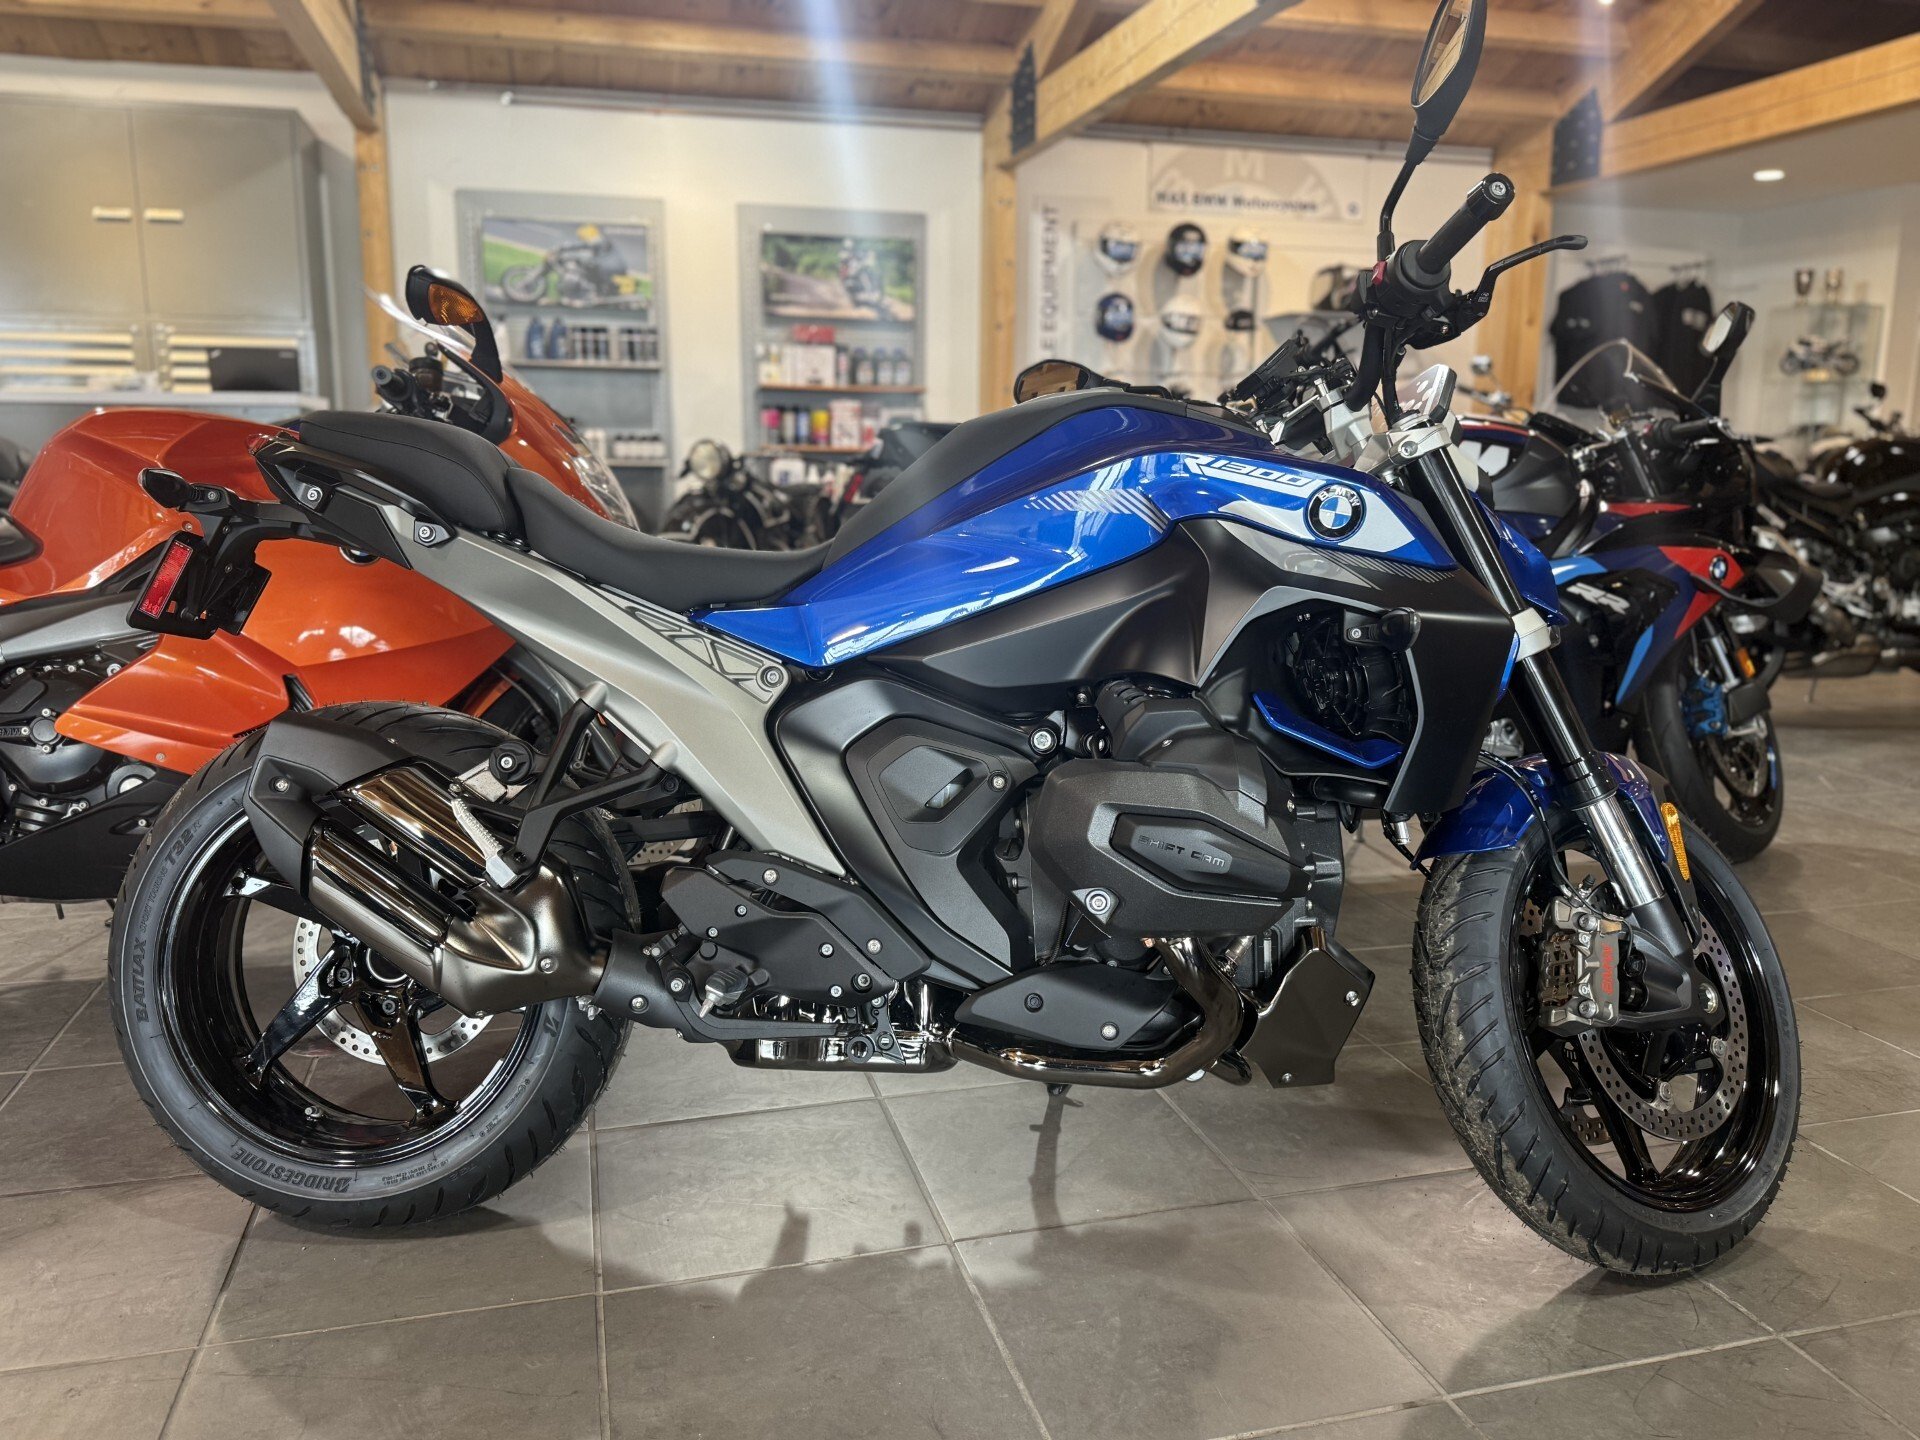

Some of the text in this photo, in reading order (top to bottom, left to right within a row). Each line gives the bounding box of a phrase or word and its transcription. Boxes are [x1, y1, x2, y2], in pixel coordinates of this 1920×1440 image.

[1316, 485, 1361, 507] BMW
[1566, 582, 1631, 615] RR
[1138, 834, 1186, 855] SHIFT
[132, 937, 150, 1023] BATTLAX
[230, 1148, 352, 1194] BRIDGESTONE
